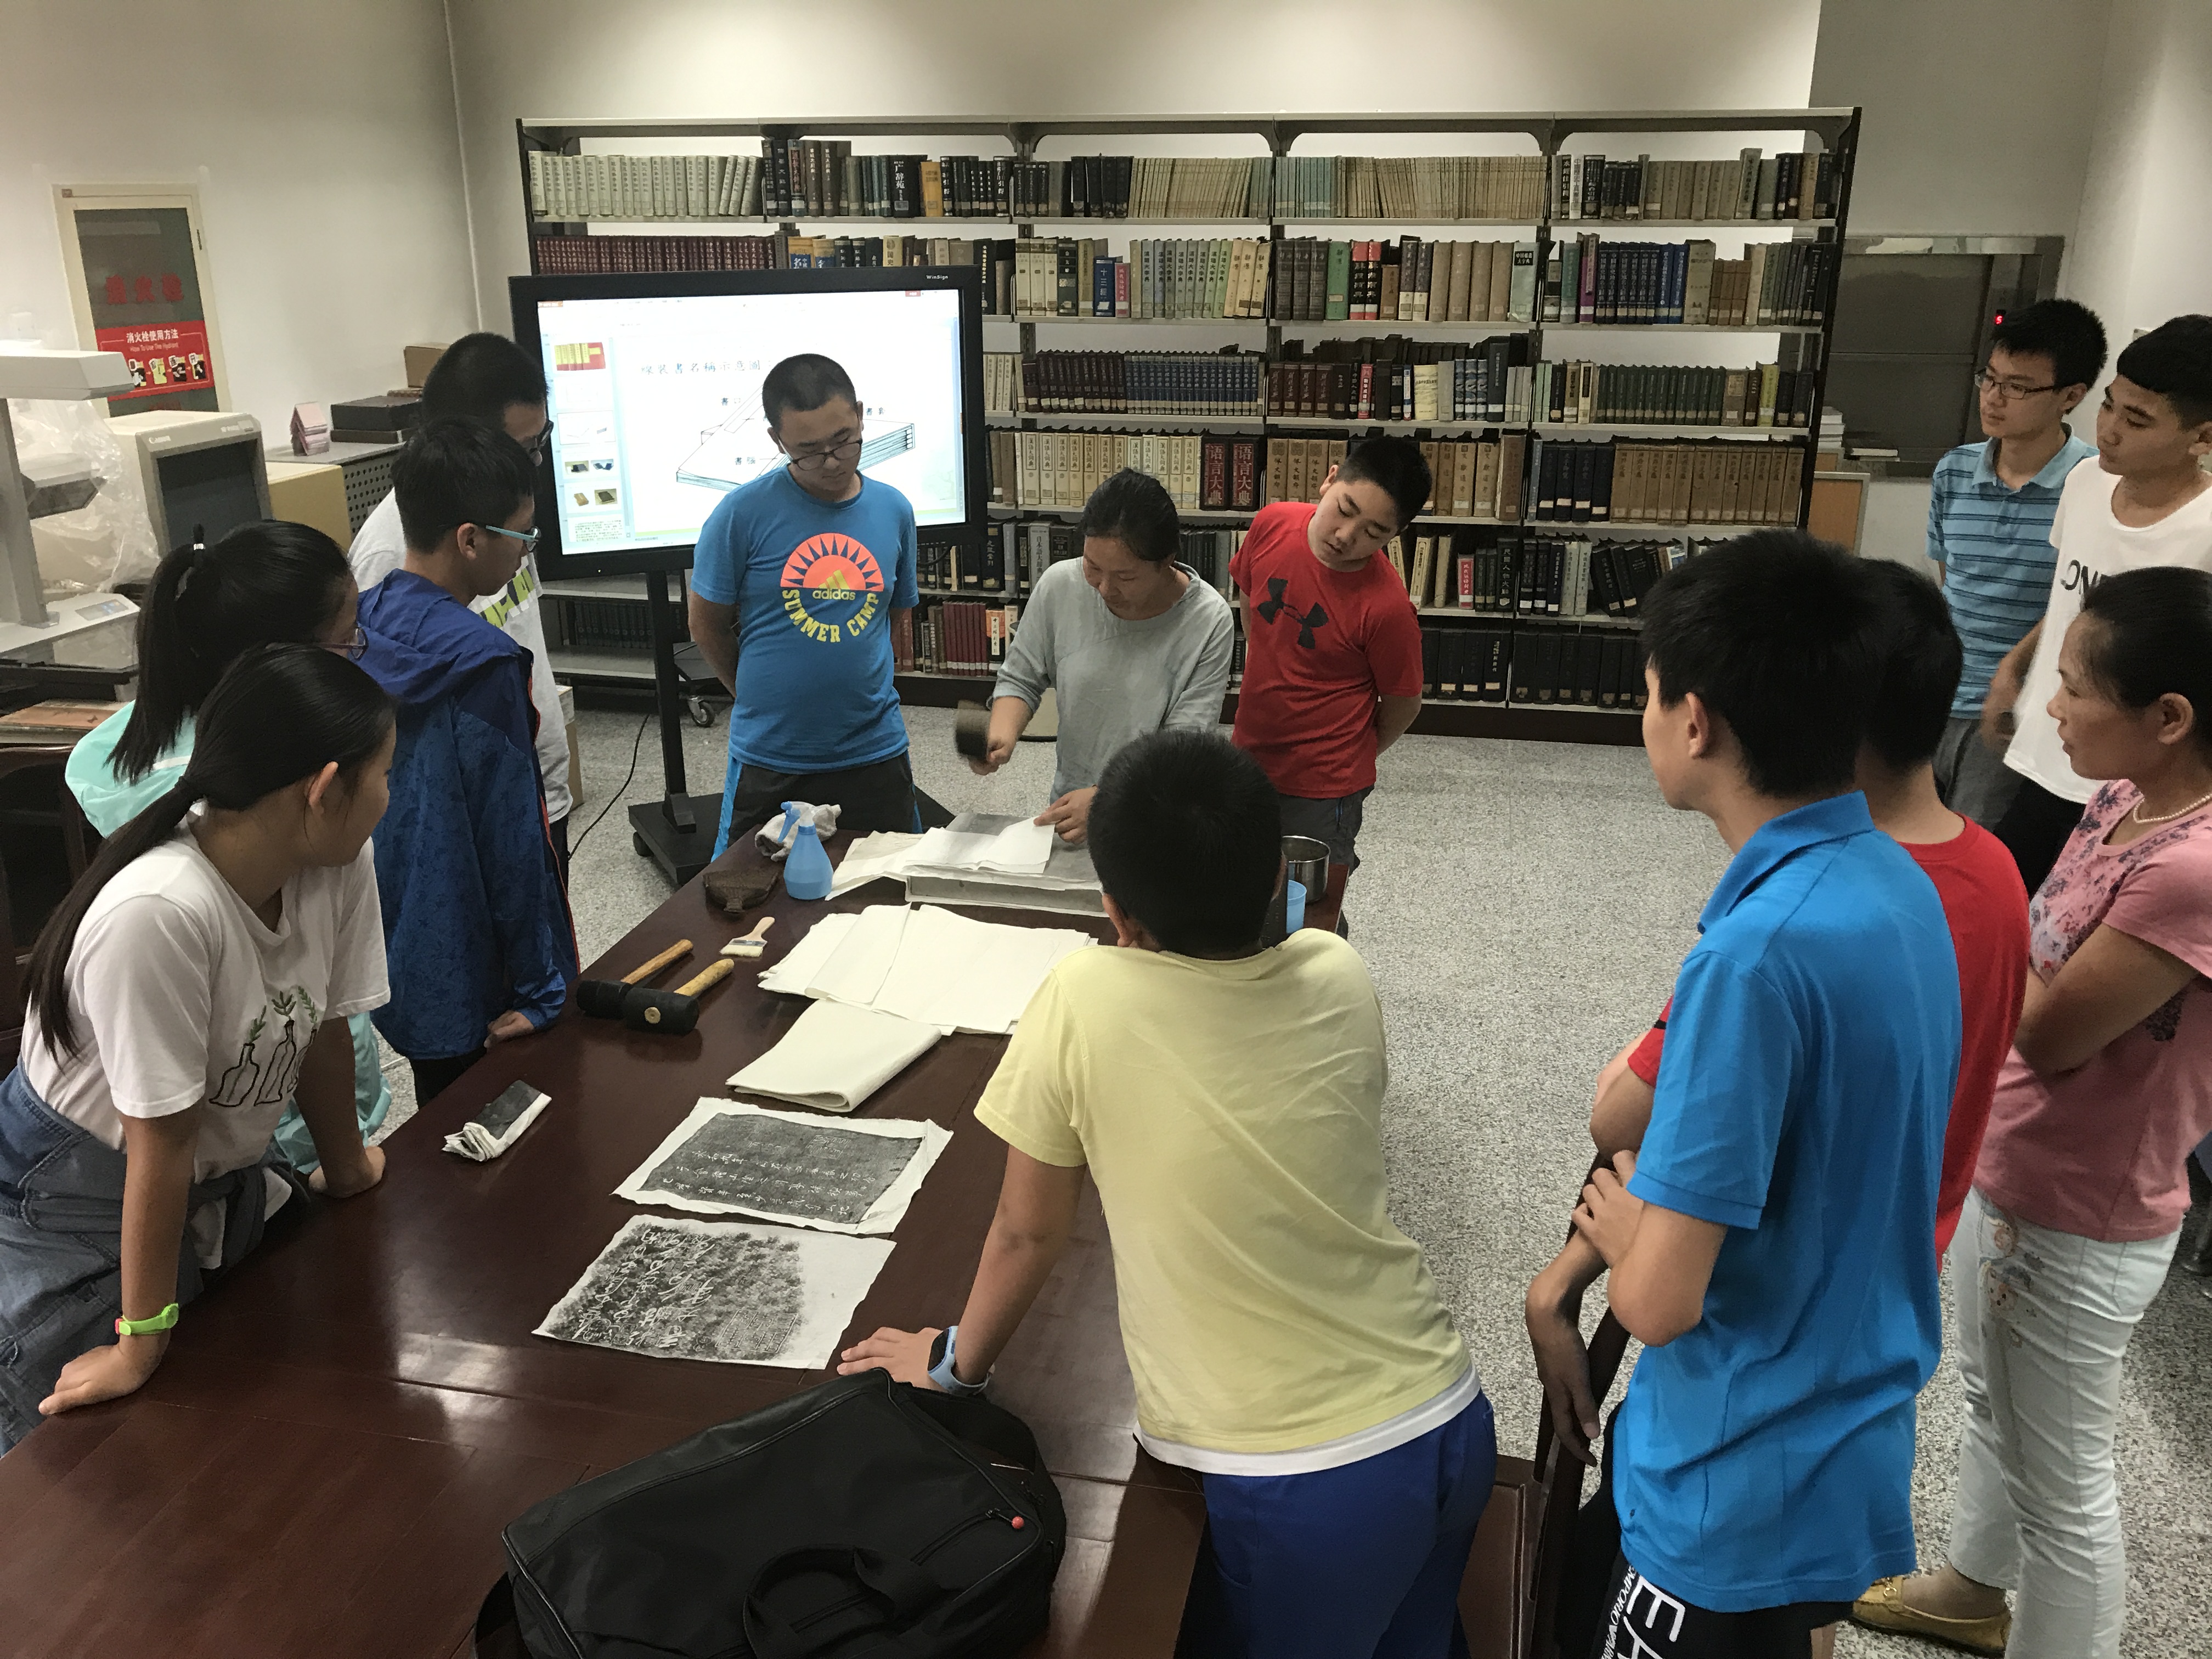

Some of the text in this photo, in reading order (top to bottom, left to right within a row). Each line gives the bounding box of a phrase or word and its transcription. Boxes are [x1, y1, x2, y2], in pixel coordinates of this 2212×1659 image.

[126, 329, 179, 343] 消火栓使用方法
[1209, 445, 1223, 505] 语言大典
[1238, 445, 1252, 505] 语言大典
[782, 589, 840, 643] SUMMER
[847, 592, 879, 636] CAMP
[812, 590, 856, 600] adidas
